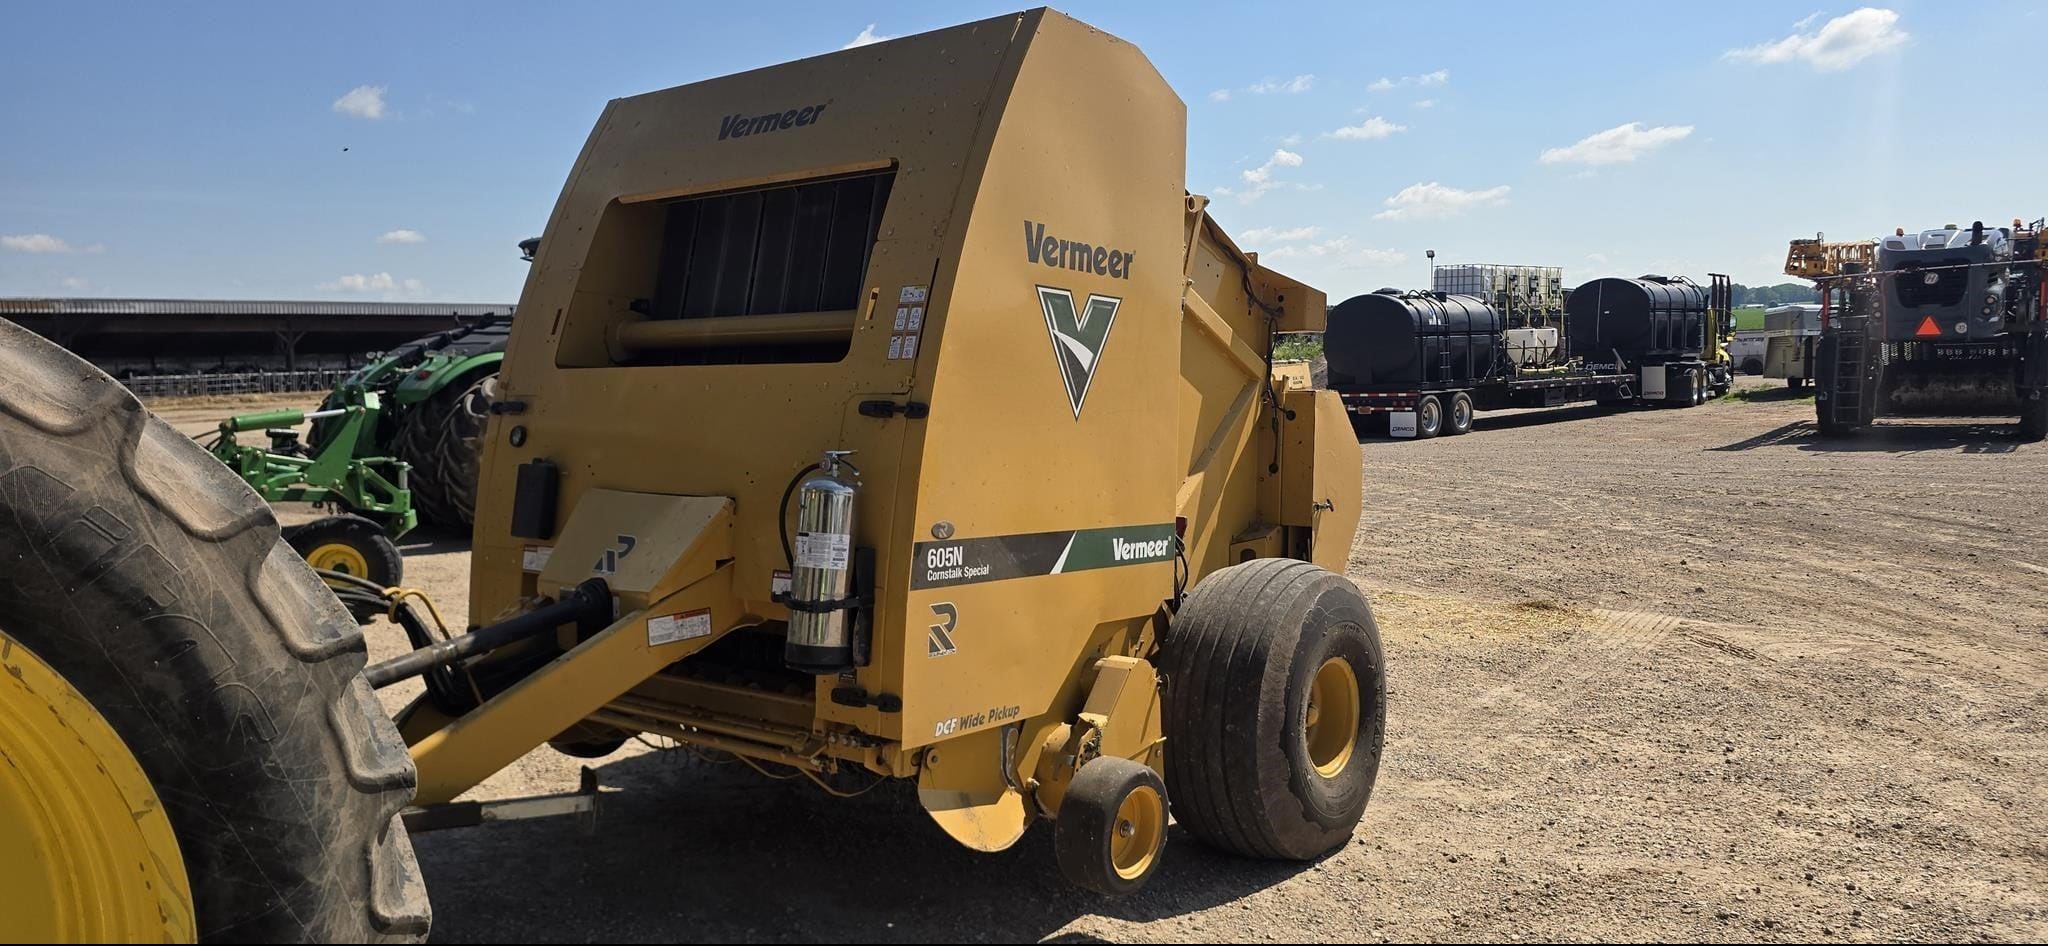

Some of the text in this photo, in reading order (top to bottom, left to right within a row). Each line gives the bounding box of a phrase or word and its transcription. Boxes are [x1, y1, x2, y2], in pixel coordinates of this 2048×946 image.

[719, 105, 826, 140] Vermeer
[1024, 220, 1133, 280] Vermeer
[927, 546, 963, 569] 605N
[1113, 537, 1168, 560] Vermeer
[927, 564, 990, 581] Cornstalk Special
[935, 704, 1020, 738] DCF Wide Pickup
